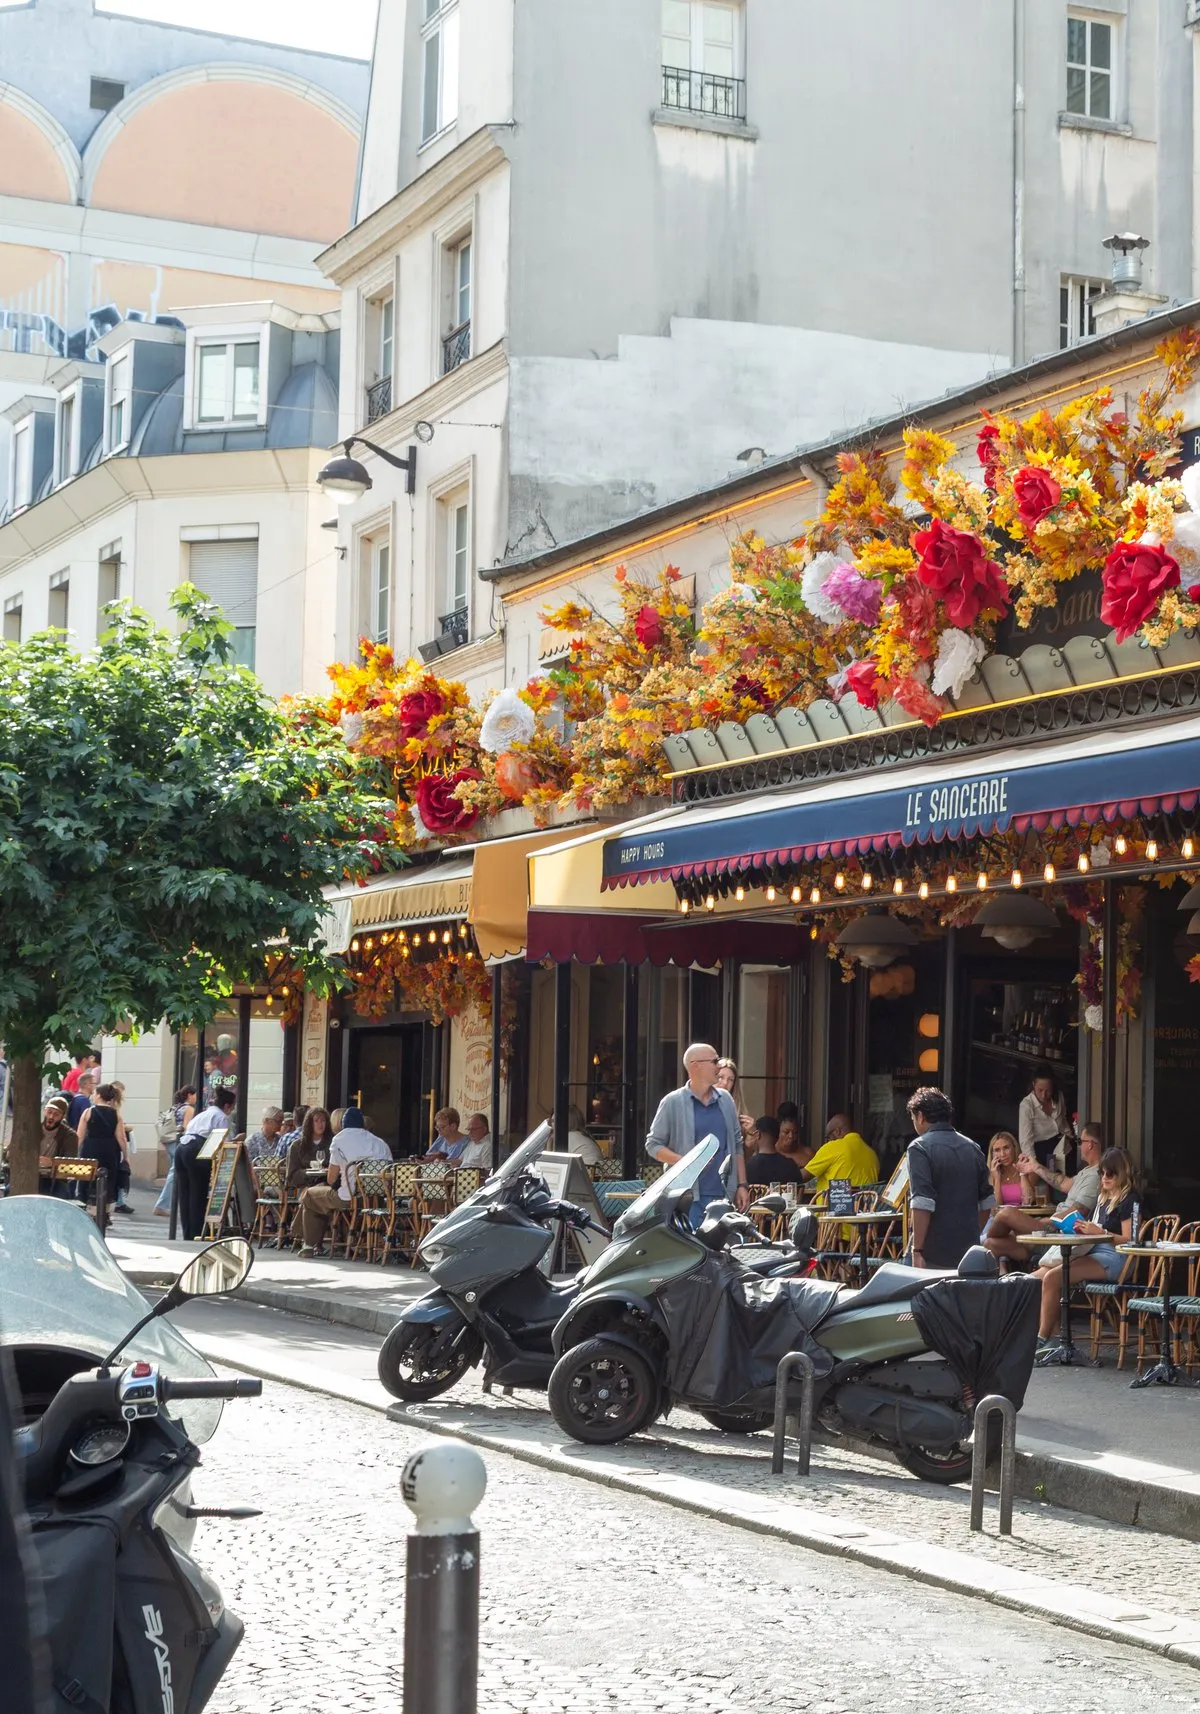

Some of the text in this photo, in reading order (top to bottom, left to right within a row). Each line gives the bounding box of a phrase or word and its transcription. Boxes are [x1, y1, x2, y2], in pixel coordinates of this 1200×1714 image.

[906, 777, 1009, 826] LE SANCERRE
[620, 841, 665, 865] HAPPY HOURS
